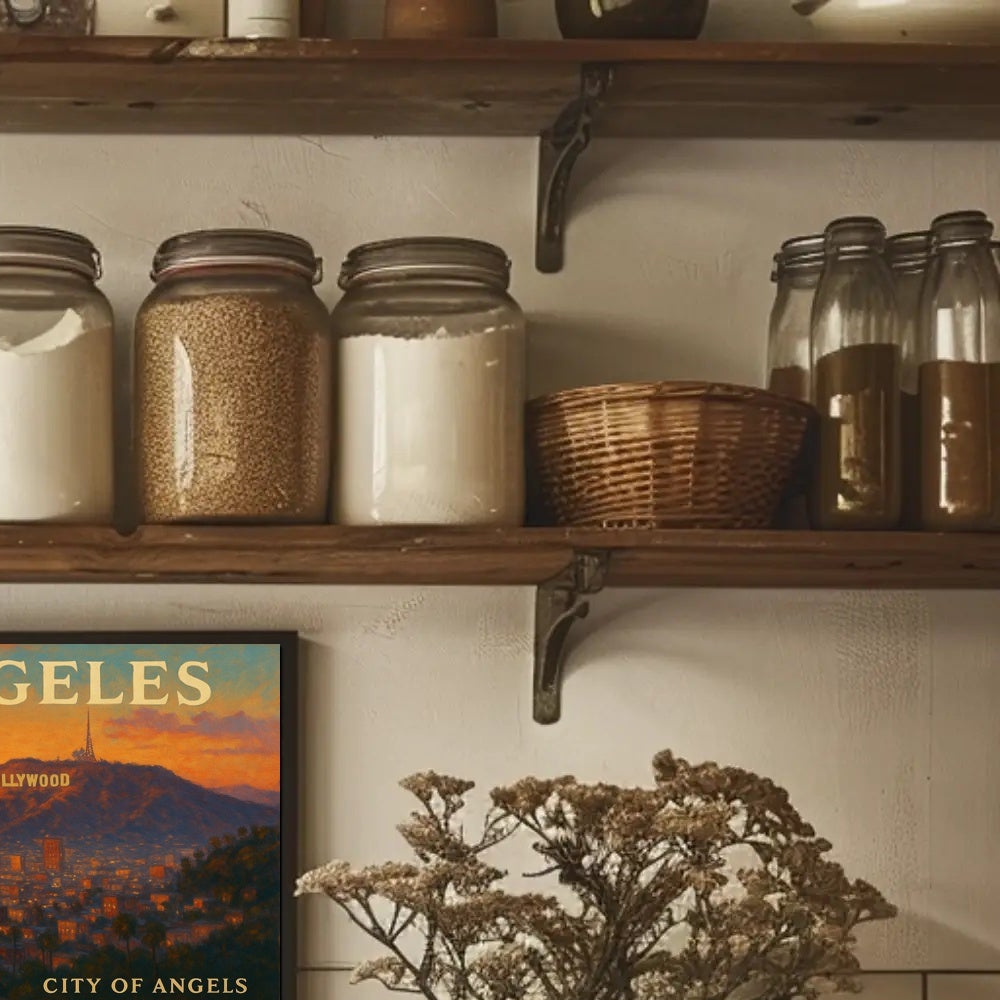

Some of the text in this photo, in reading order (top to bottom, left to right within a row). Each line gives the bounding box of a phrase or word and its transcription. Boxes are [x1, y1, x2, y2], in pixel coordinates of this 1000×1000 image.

[42, 977, 248, 994] CITY OF ANGELS
